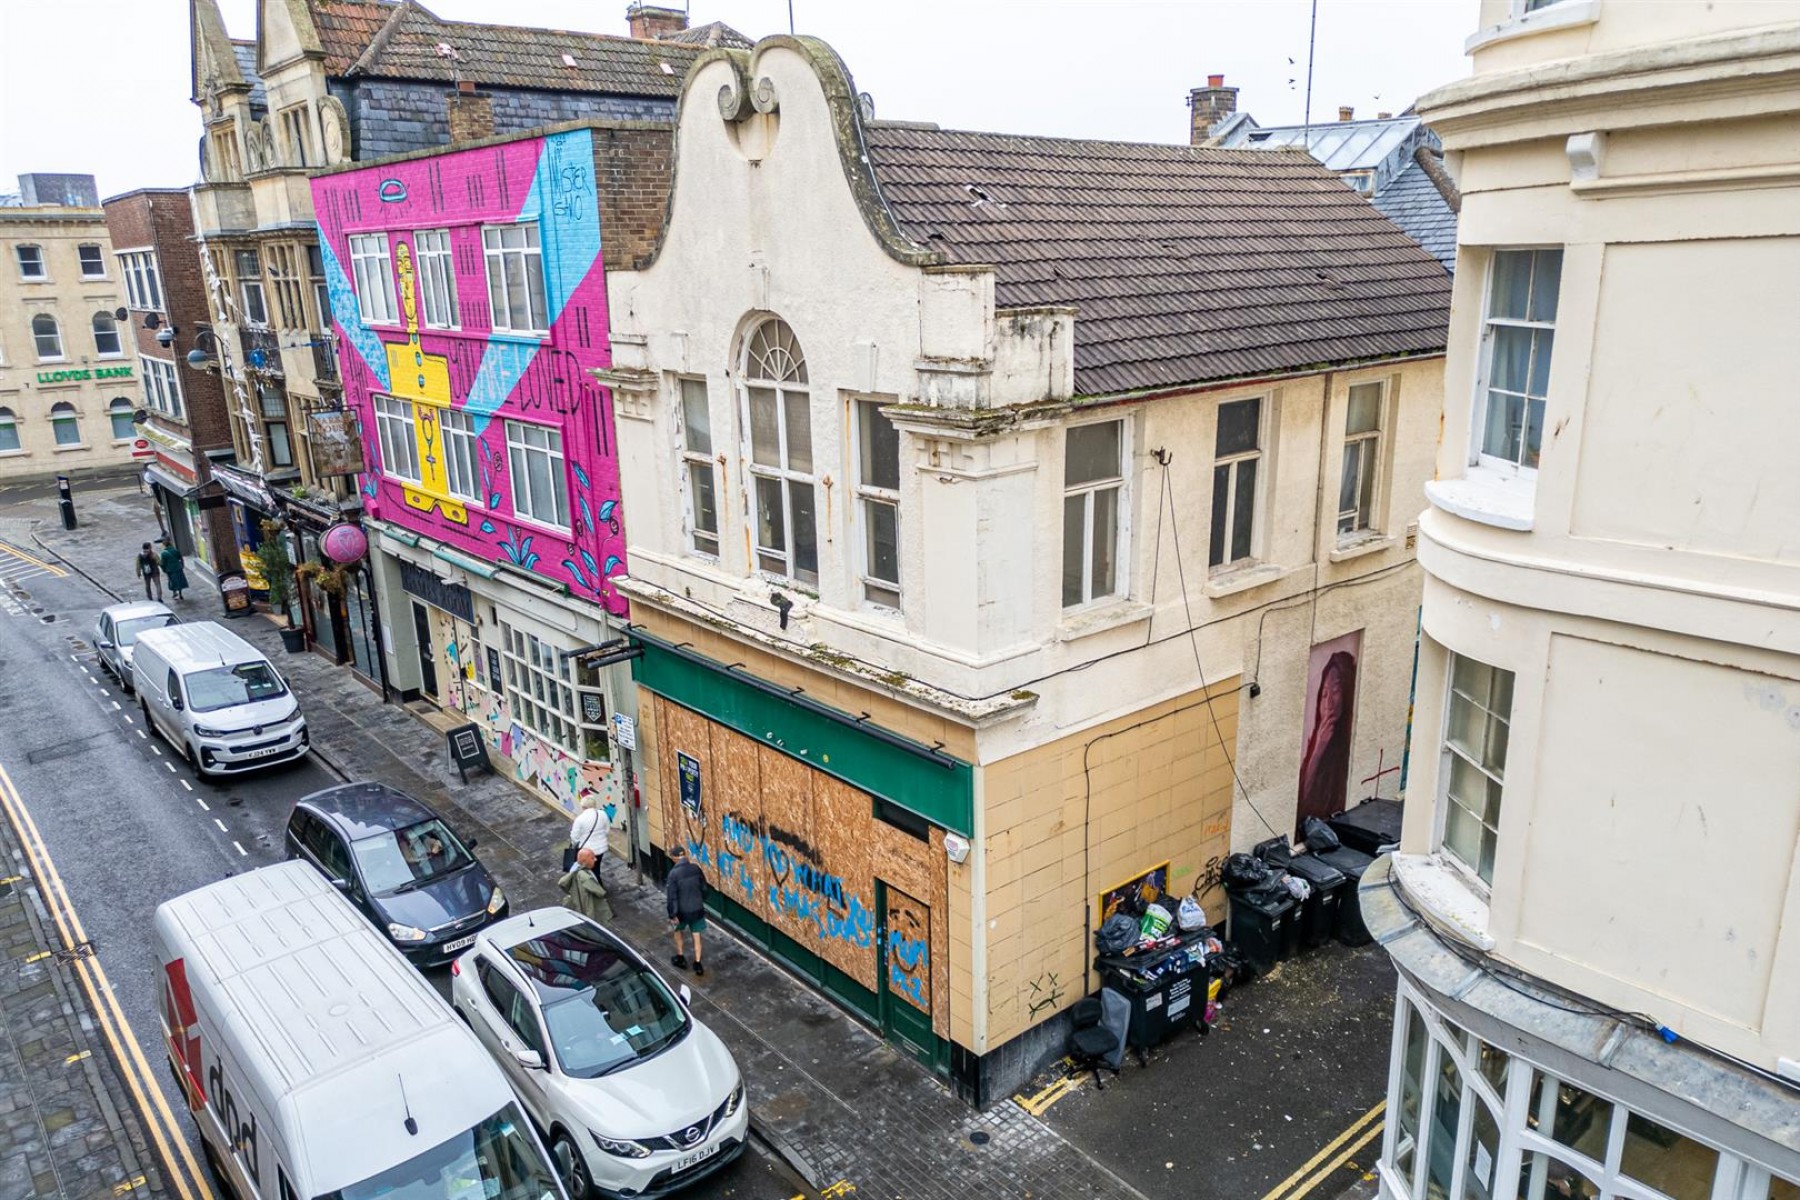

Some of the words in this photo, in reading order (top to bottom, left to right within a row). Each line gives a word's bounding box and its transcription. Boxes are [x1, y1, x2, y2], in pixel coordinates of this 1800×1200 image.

[37, 370, 91, 383] LLOYDS
[95, 367, 133, 379] BANK
[447, 340, 485, 400] YOU
[469, 343, 513, 404] ARE
[513, 343, 581, 415] LOVED
[209, 1055, 261, 1189] dpd
[678, 1156, 697, 1169] LF16
[699, 1146, 714, 1160] DJV
